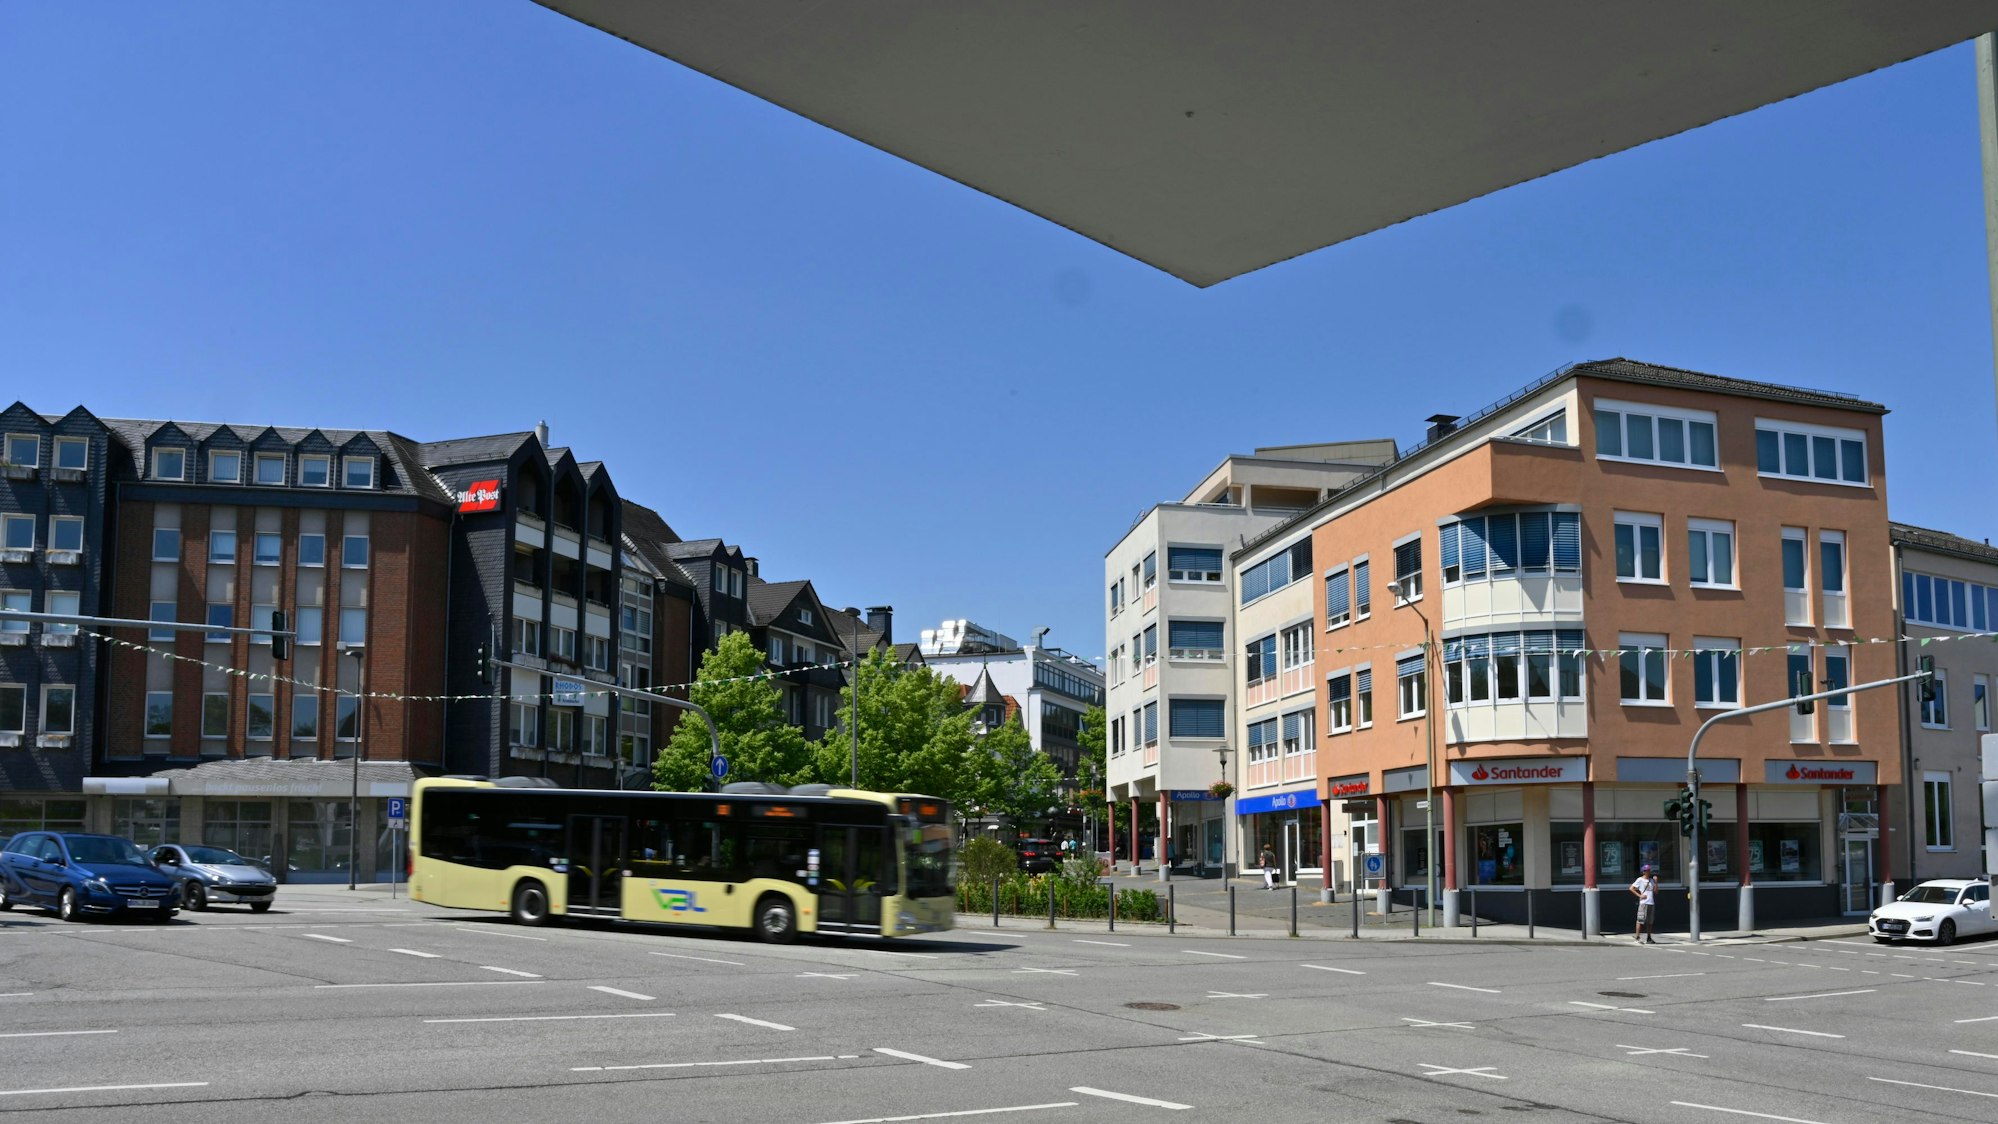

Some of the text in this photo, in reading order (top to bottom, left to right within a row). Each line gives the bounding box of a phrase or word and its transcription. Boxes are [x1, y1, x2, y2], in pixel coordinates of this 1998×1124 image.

[456, 488, 500, 504] Alte Post
[1491, 765, 1563, 779] Santander
[1800, 767, 1855, 780] Santander
[235, 783, 288, 794] pausenlos
[1176, 791, 1201, 799] Apollo
[1272, 795, 1286, 808] Apollo
[392, 801, 401, 816] P
[1604, 849, 1618, 861] 75
